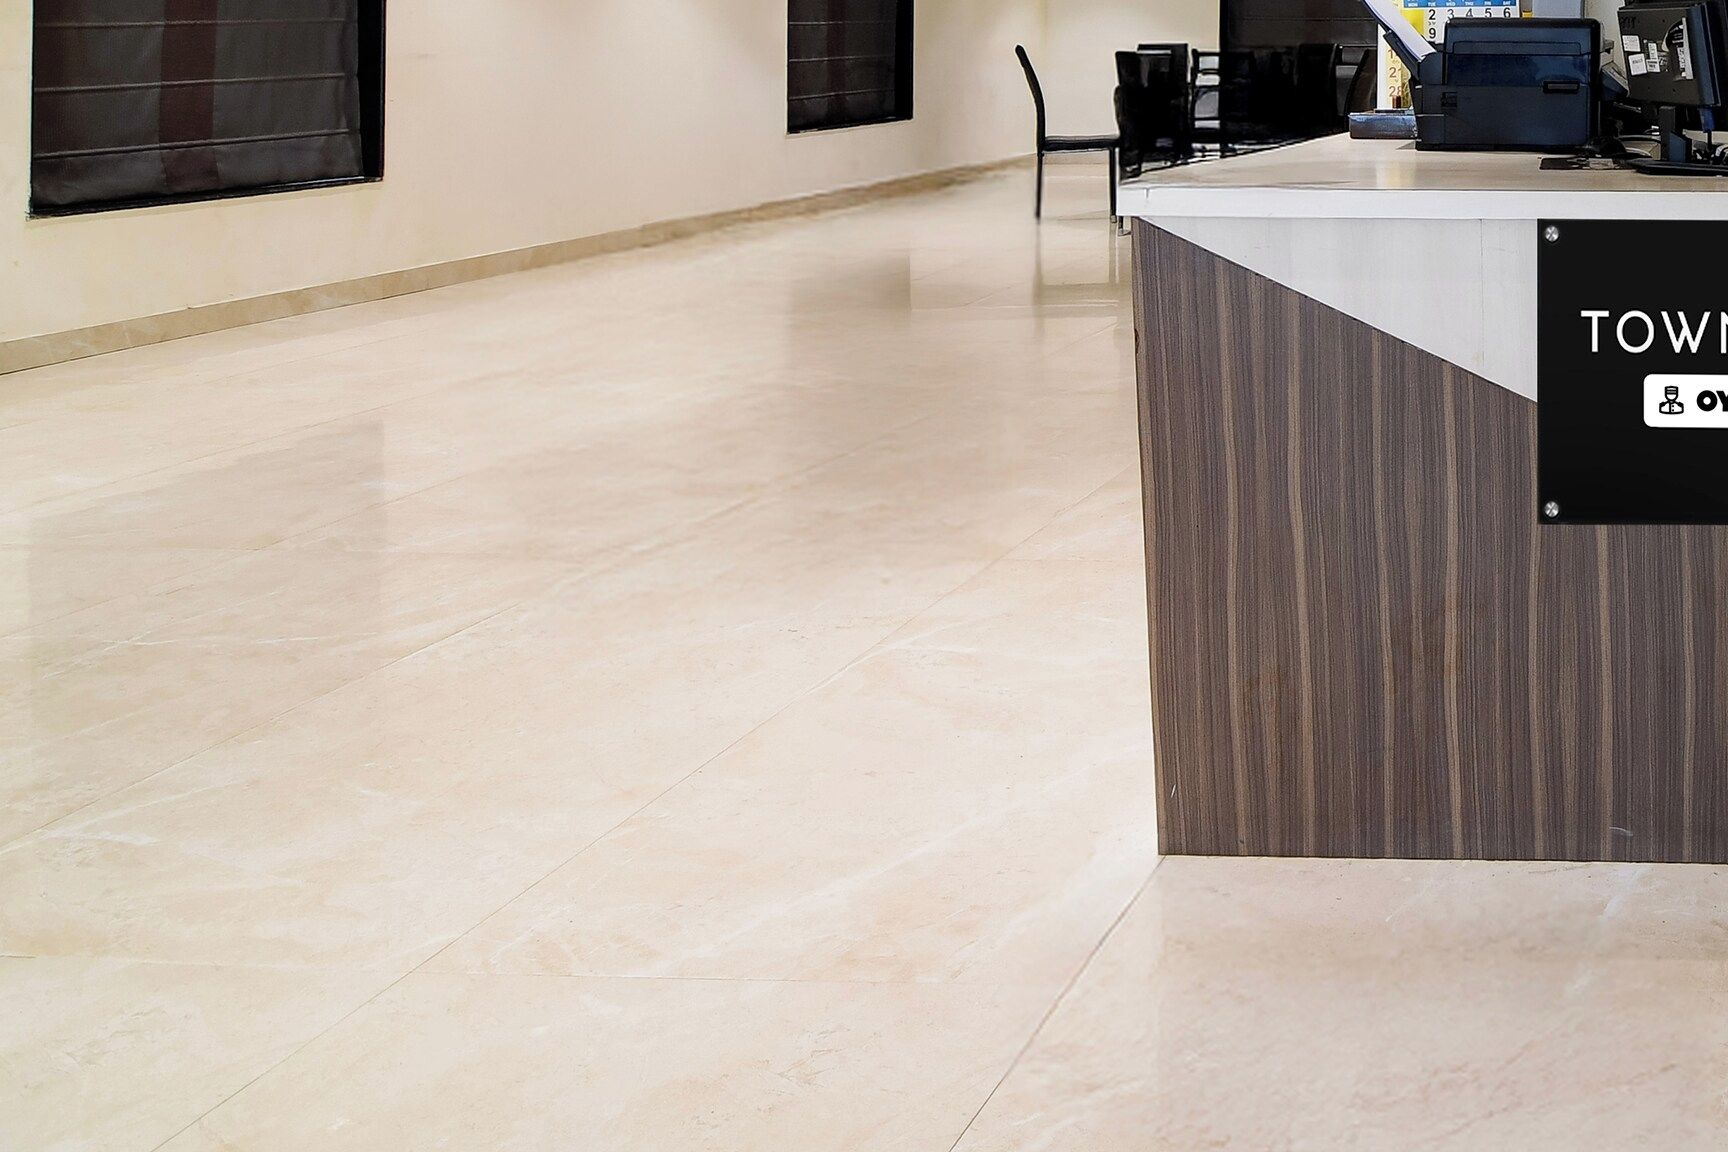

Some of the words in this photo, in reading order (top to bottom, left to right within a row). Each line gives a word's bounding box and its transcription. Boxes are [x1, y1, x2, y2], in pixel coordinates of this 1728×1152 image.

[1428, 9, 1436, 21] 2
[1447, 8, 1455, 19] 3
[1465, 8, 1473, 18] 4
[1484, 8, 1492, 18] 5
[1503, 7, 1511, 18] 6
[1428, 27, 1436, 39] 9
